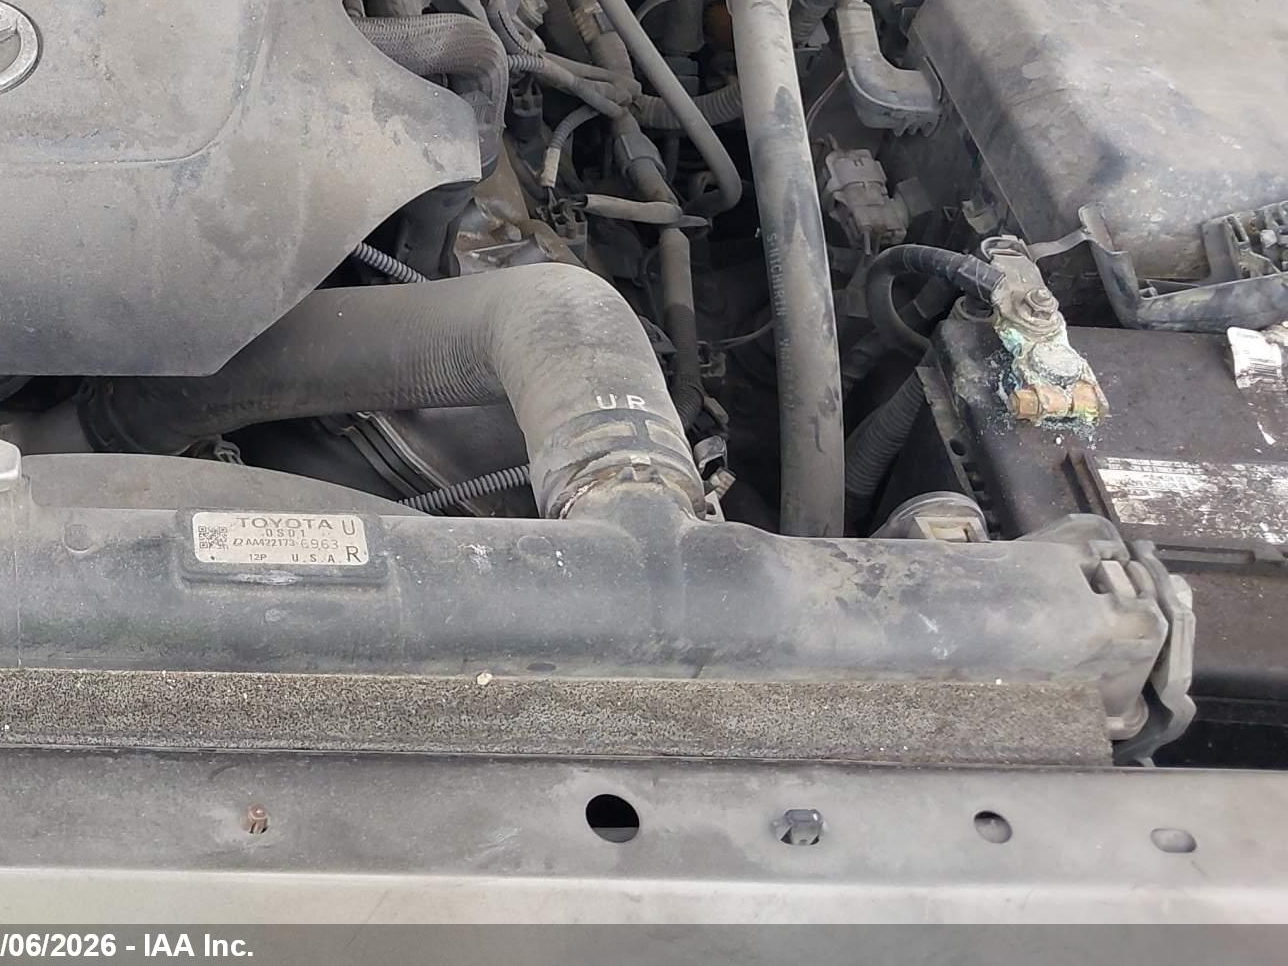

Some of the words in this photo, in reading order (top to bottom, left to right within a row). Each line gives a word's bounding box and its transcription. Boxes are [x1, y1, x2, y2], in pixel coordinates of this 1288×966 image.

[235, 517, 334, 530] TOYOTA
[341, 519, 357, 536] U
[345, 545, 362, 563] R
